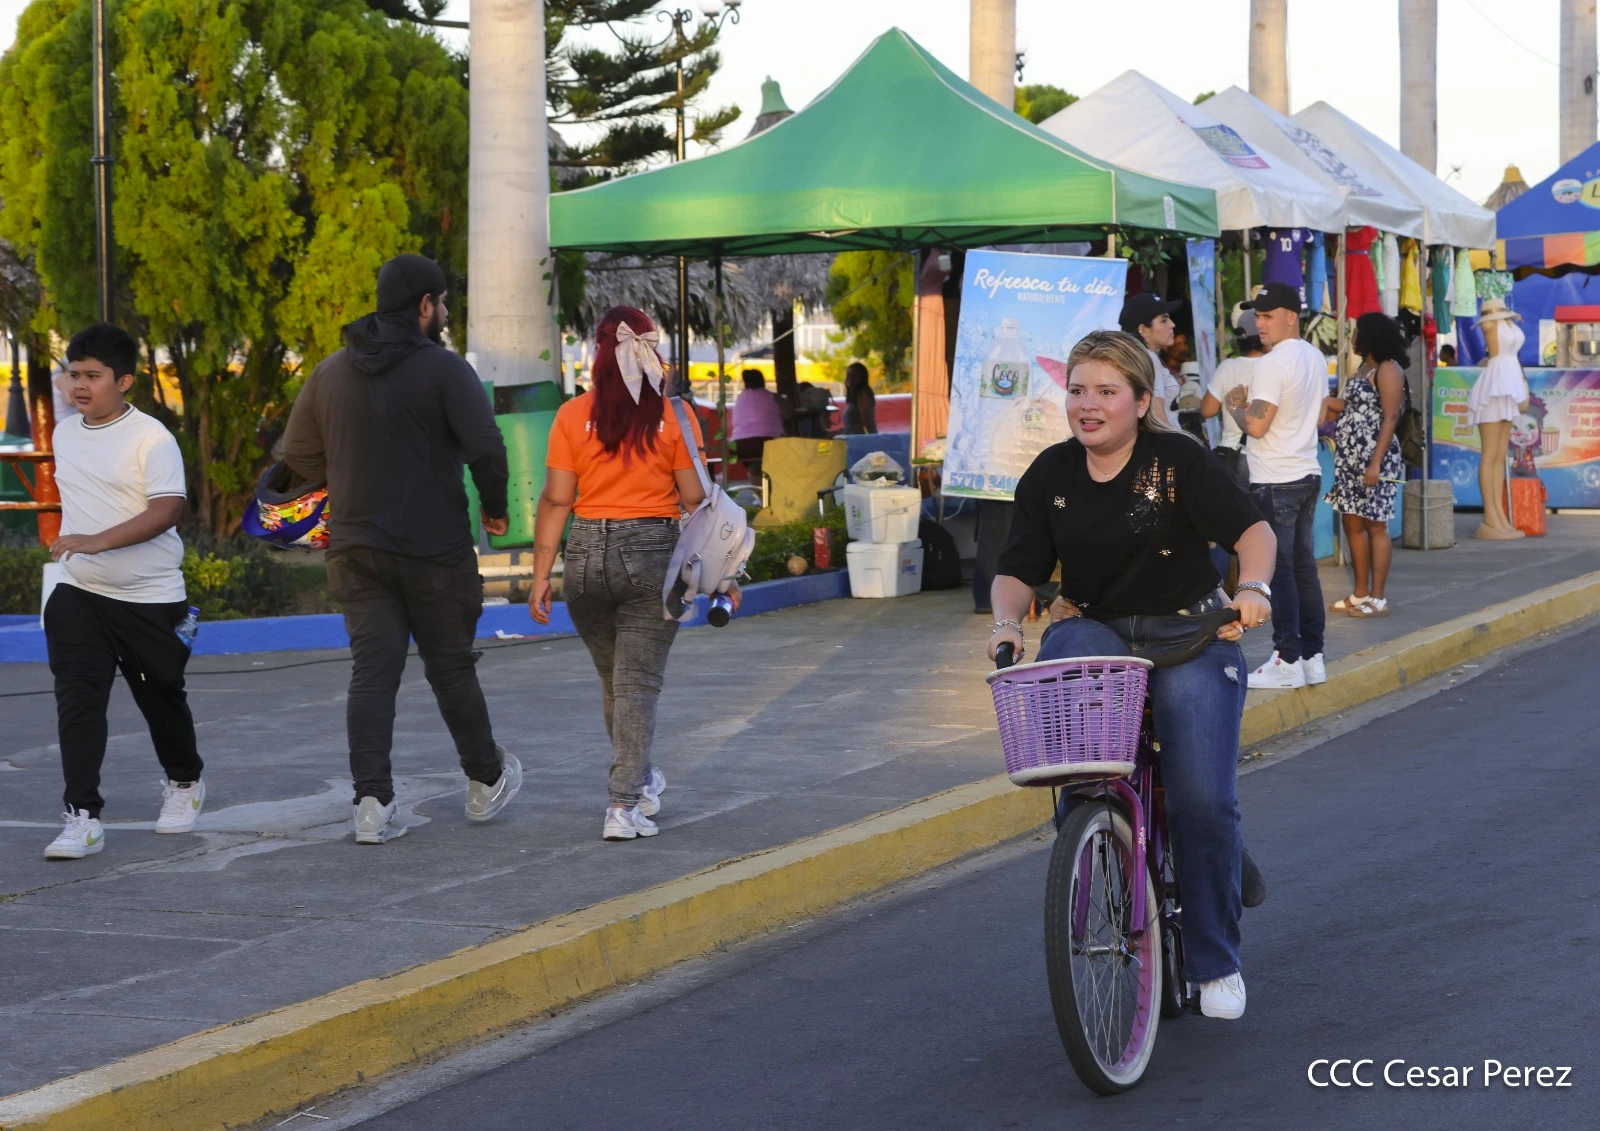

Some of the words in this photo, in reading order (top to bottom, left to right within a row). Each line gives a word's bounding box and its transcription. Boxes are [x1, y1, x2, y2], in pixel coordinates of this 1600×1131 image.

[1280, 237, 1292, 252] 10
[973, 268, 1054, 299] Refresca
[1056, 276, 1081, 293] tu
[1017, 291, 1066, 304] NATURALMENTE
[992, 363, 1020, 381] Coco
[950, 472, 985, 490] 5770
